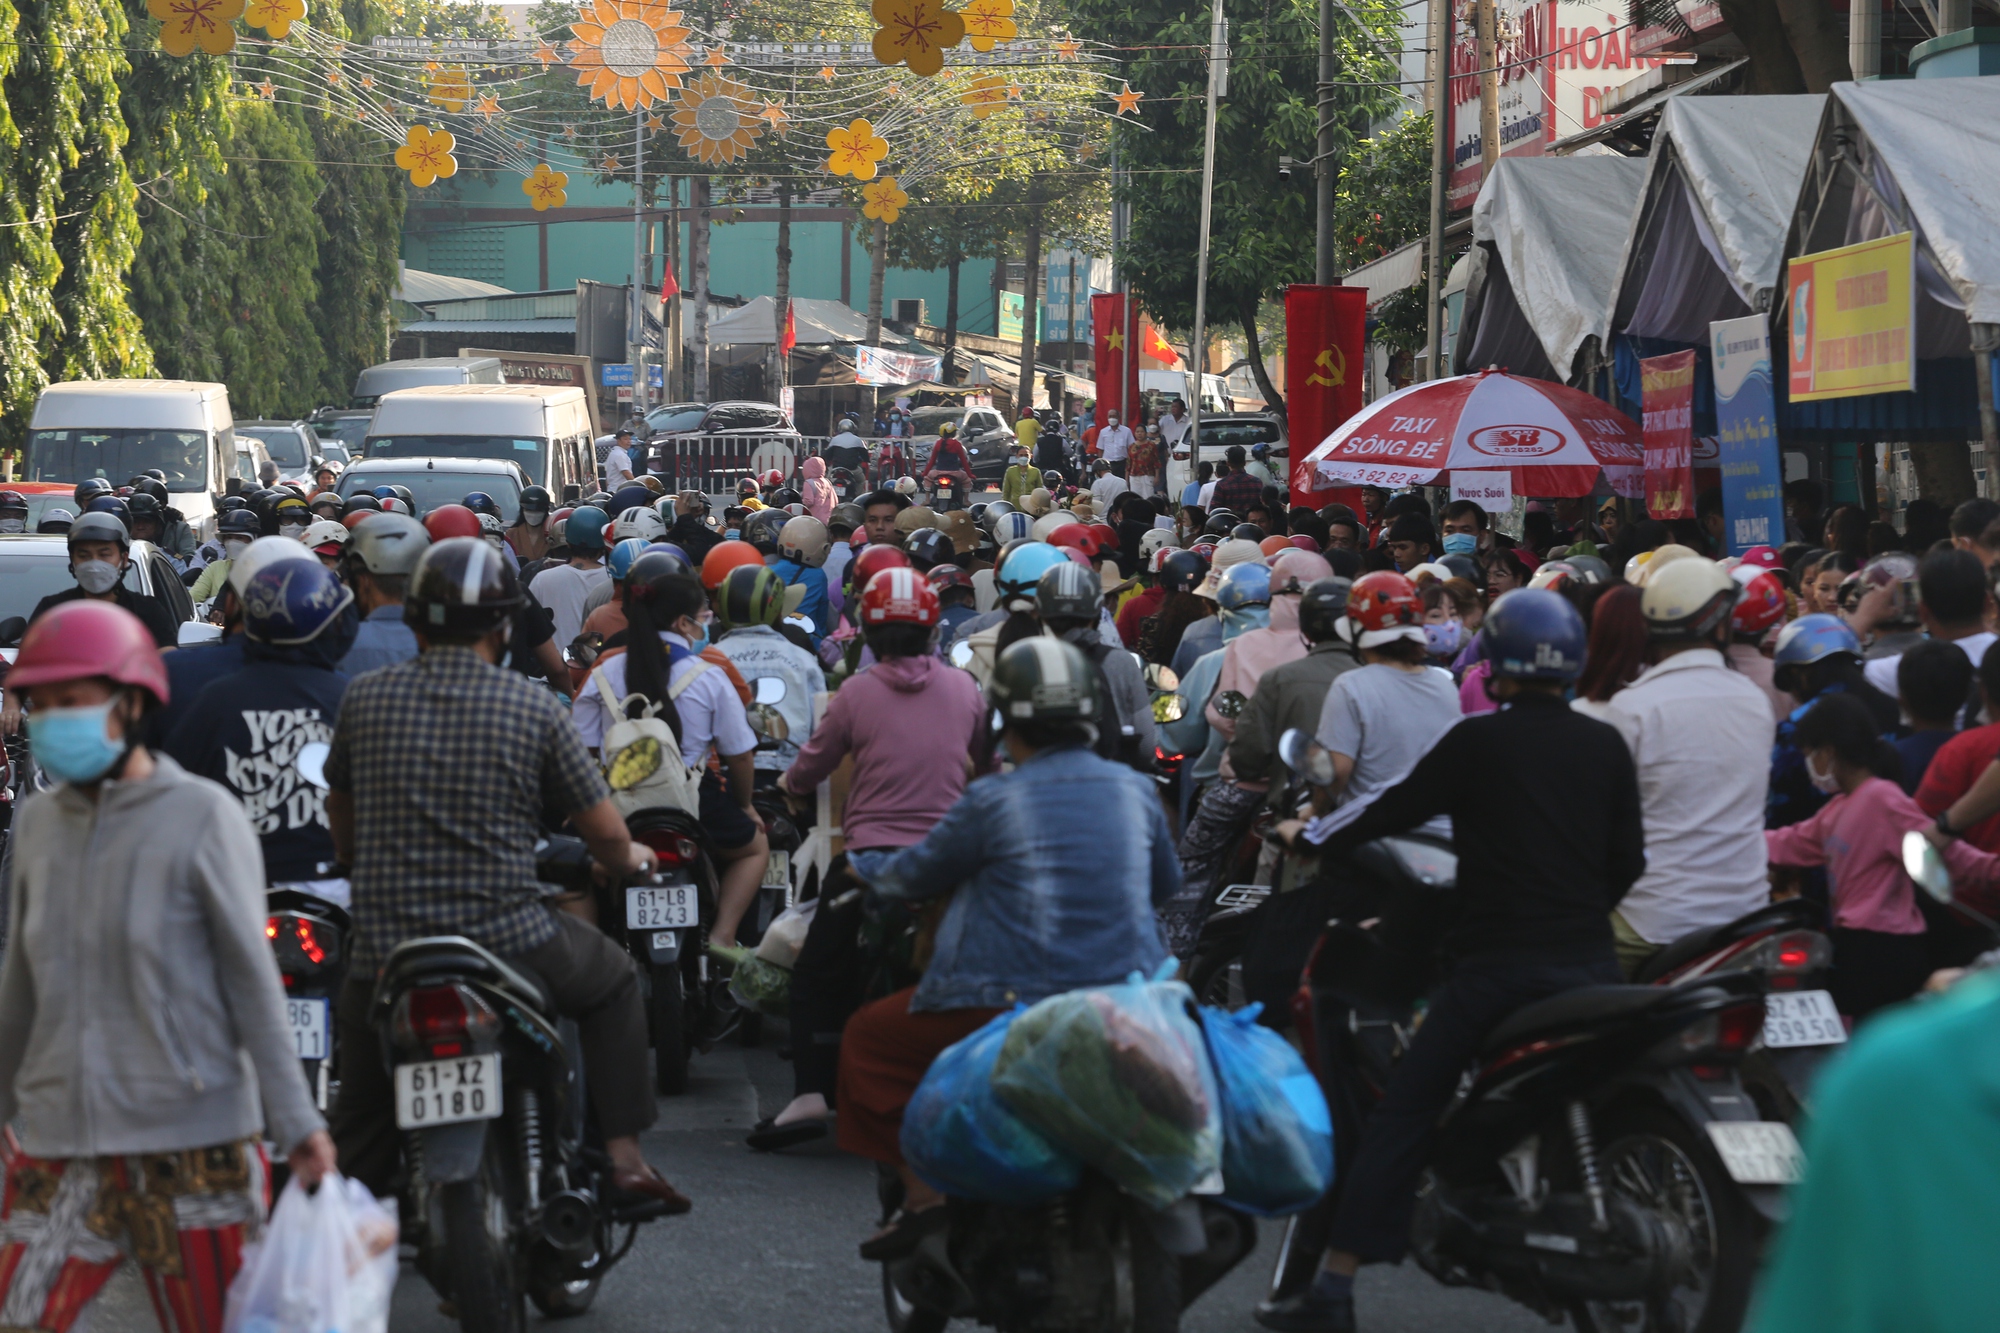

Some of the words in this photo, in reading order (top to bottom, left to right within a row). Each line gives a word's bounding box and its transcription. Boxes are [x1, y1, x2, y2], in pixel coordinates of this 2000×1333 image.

[1558, 14, 1669, 69] HOÀN
[503, 362, 525, 378] CÔNG
[525, 366, 537, 378] TY
[1388, 416, 1437, 434] TAXI
[1583, 418, 1626, 435] TAXI
[1342, 434, 1408, 455] SÔNG
[1406, 437, 1445, 459] BÉ
[1496, 429, 1541, 446] SB
[1591, 436, 1638, 459] SÔNG
[1365, 470, 1386, 483] 82
[1386, 472, 1407, 484] 82
[1458, 487, 1482, 498] Nước
[1484, 486, 1505, 498] Suối
[637, 889, 686, 907] 61-L8
[638, 907, 687, 925] 8243
[412, 1059, 483, 1092] 61-X2
[412, 1088, 485, 1120] 0180
